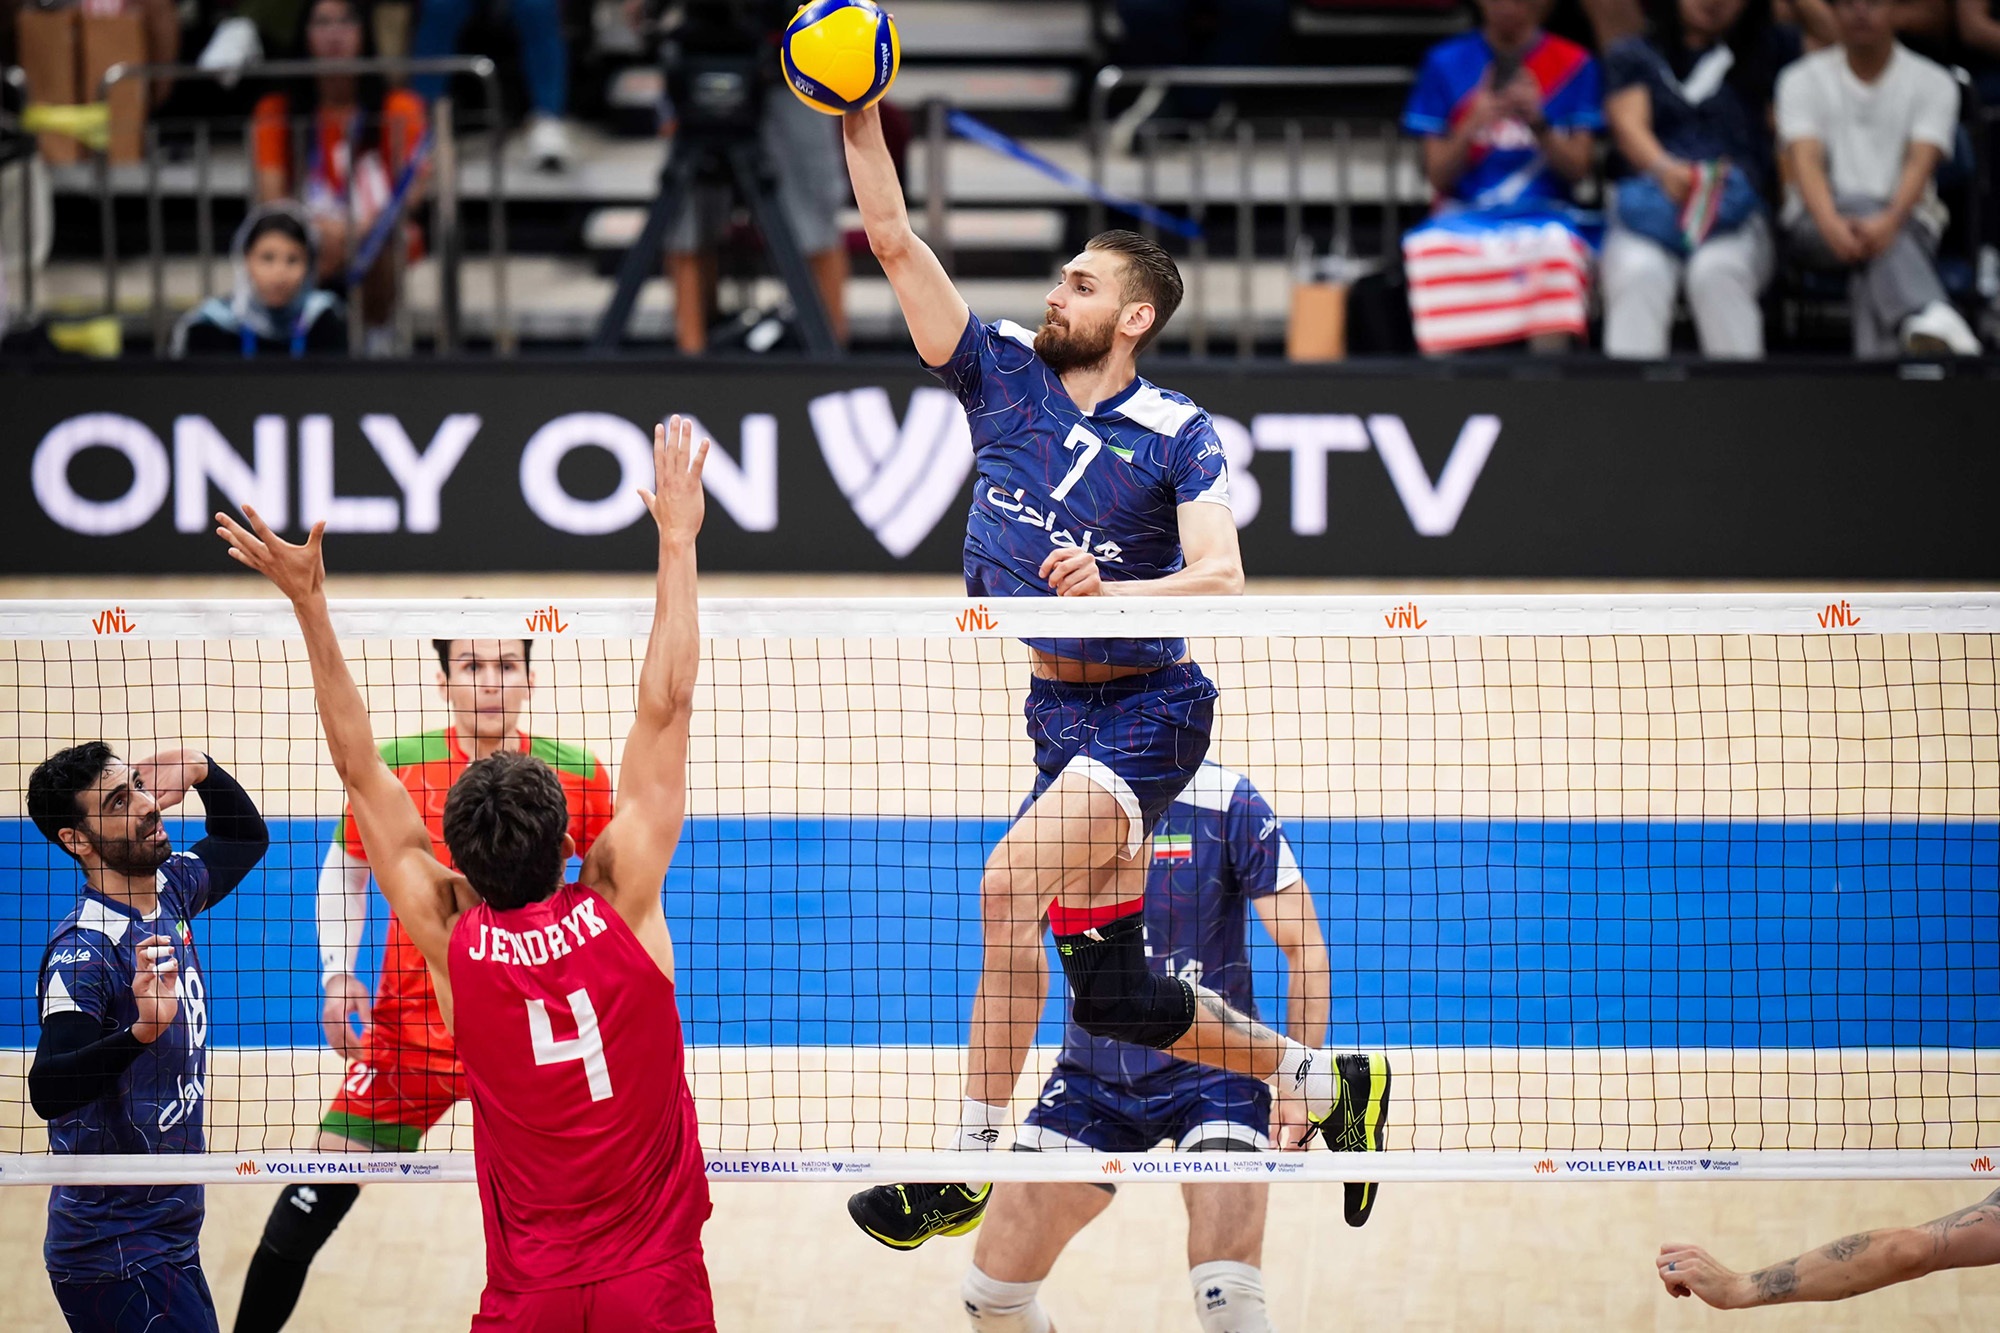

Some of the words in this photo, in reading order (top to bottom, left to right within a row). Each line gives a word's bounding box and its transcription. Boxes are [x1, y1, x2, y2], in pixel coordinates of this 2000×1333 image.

[31, 412, 481, 537] ONLY
[520, 412, 778, 536] ON
[1050, 423, 1101, 502] 7
[468, 897, 608, 967] JENDRYK
[174, 966, 207, 1056] 18
[525, 987, 614, 1103] 4
[344, 1063, 378, 1096] 21
[235, 1160, 260, 1175] VNL
[266, 1162, 365, 1174] VOLLEYBALL
[1102, 1159, 1126, 1174] VNL
[1133, 1161, 1231, 1173] VOLLEYBALL
[1534, 1158, 1559, 1173] VNL
[1566, 1160, 1665, 1172] VOLLEYBALL
[1971, 1156, 1996, 1172] VNL
